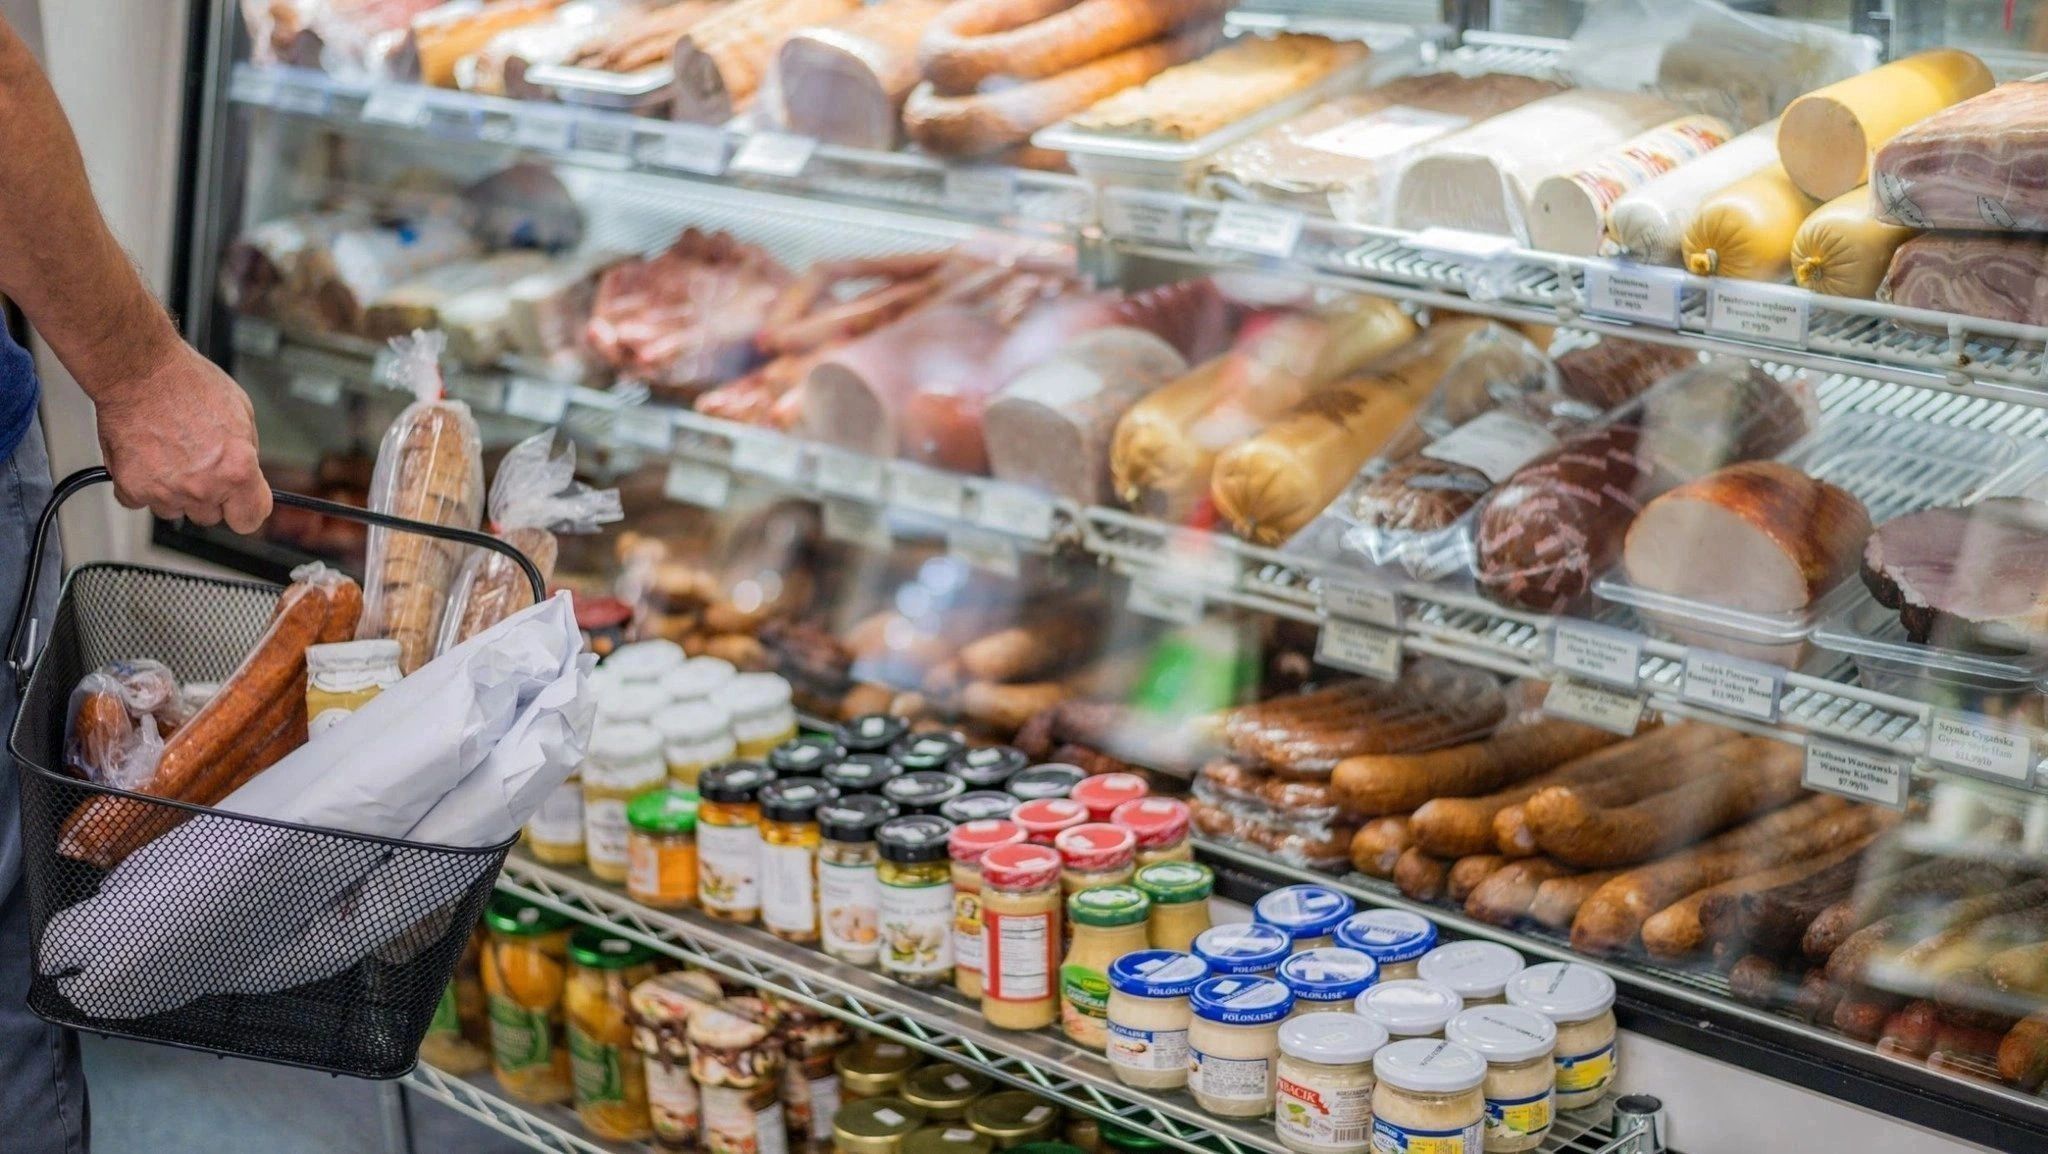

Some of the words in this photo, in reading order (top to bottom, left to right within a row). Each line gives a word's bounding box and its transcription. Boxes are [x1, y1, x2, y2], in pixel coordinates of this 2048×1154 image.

[1938, 721, 1970, 737] Szynka
[1847, 756, 1898, 776] Warszawska
[1838, 776, 1869, 791] $7.99/lb
